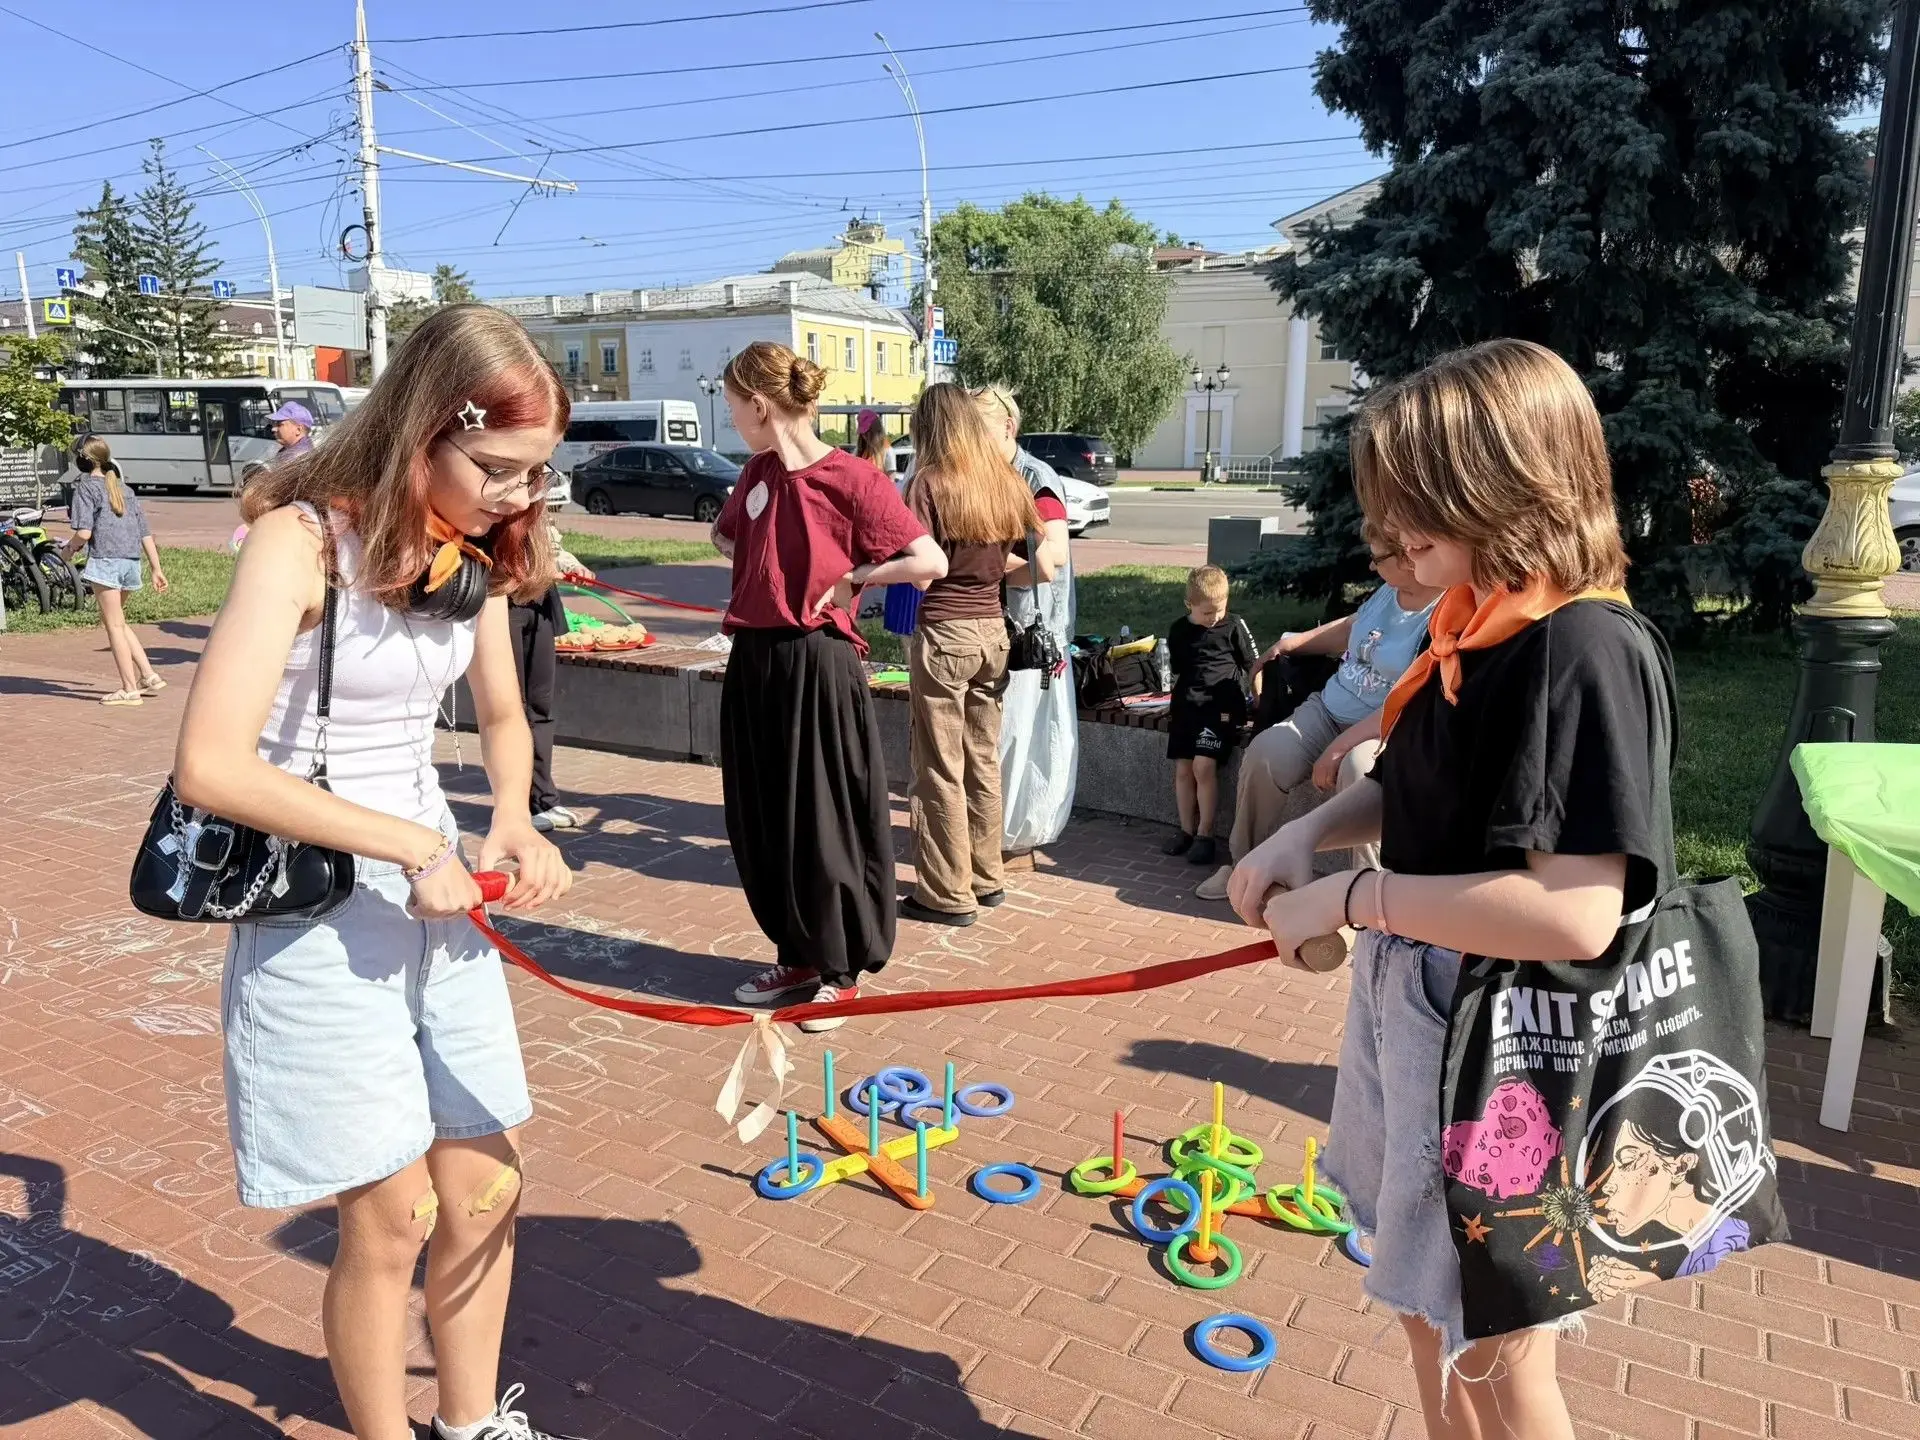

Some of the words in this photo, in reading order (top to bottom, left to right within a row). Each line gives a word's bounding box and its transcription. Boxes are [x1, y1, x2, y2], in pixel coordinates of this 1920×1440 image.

[1491, 986, 1578, 1040] EXIT
[1493, 1036, 1585, 1058] НАСЛАЖДЕНИЕ
[1494, 1051, 1544, 1075] ВЕРНЫЙ
[1553, 1056, 1581, 1073] ШАГ
